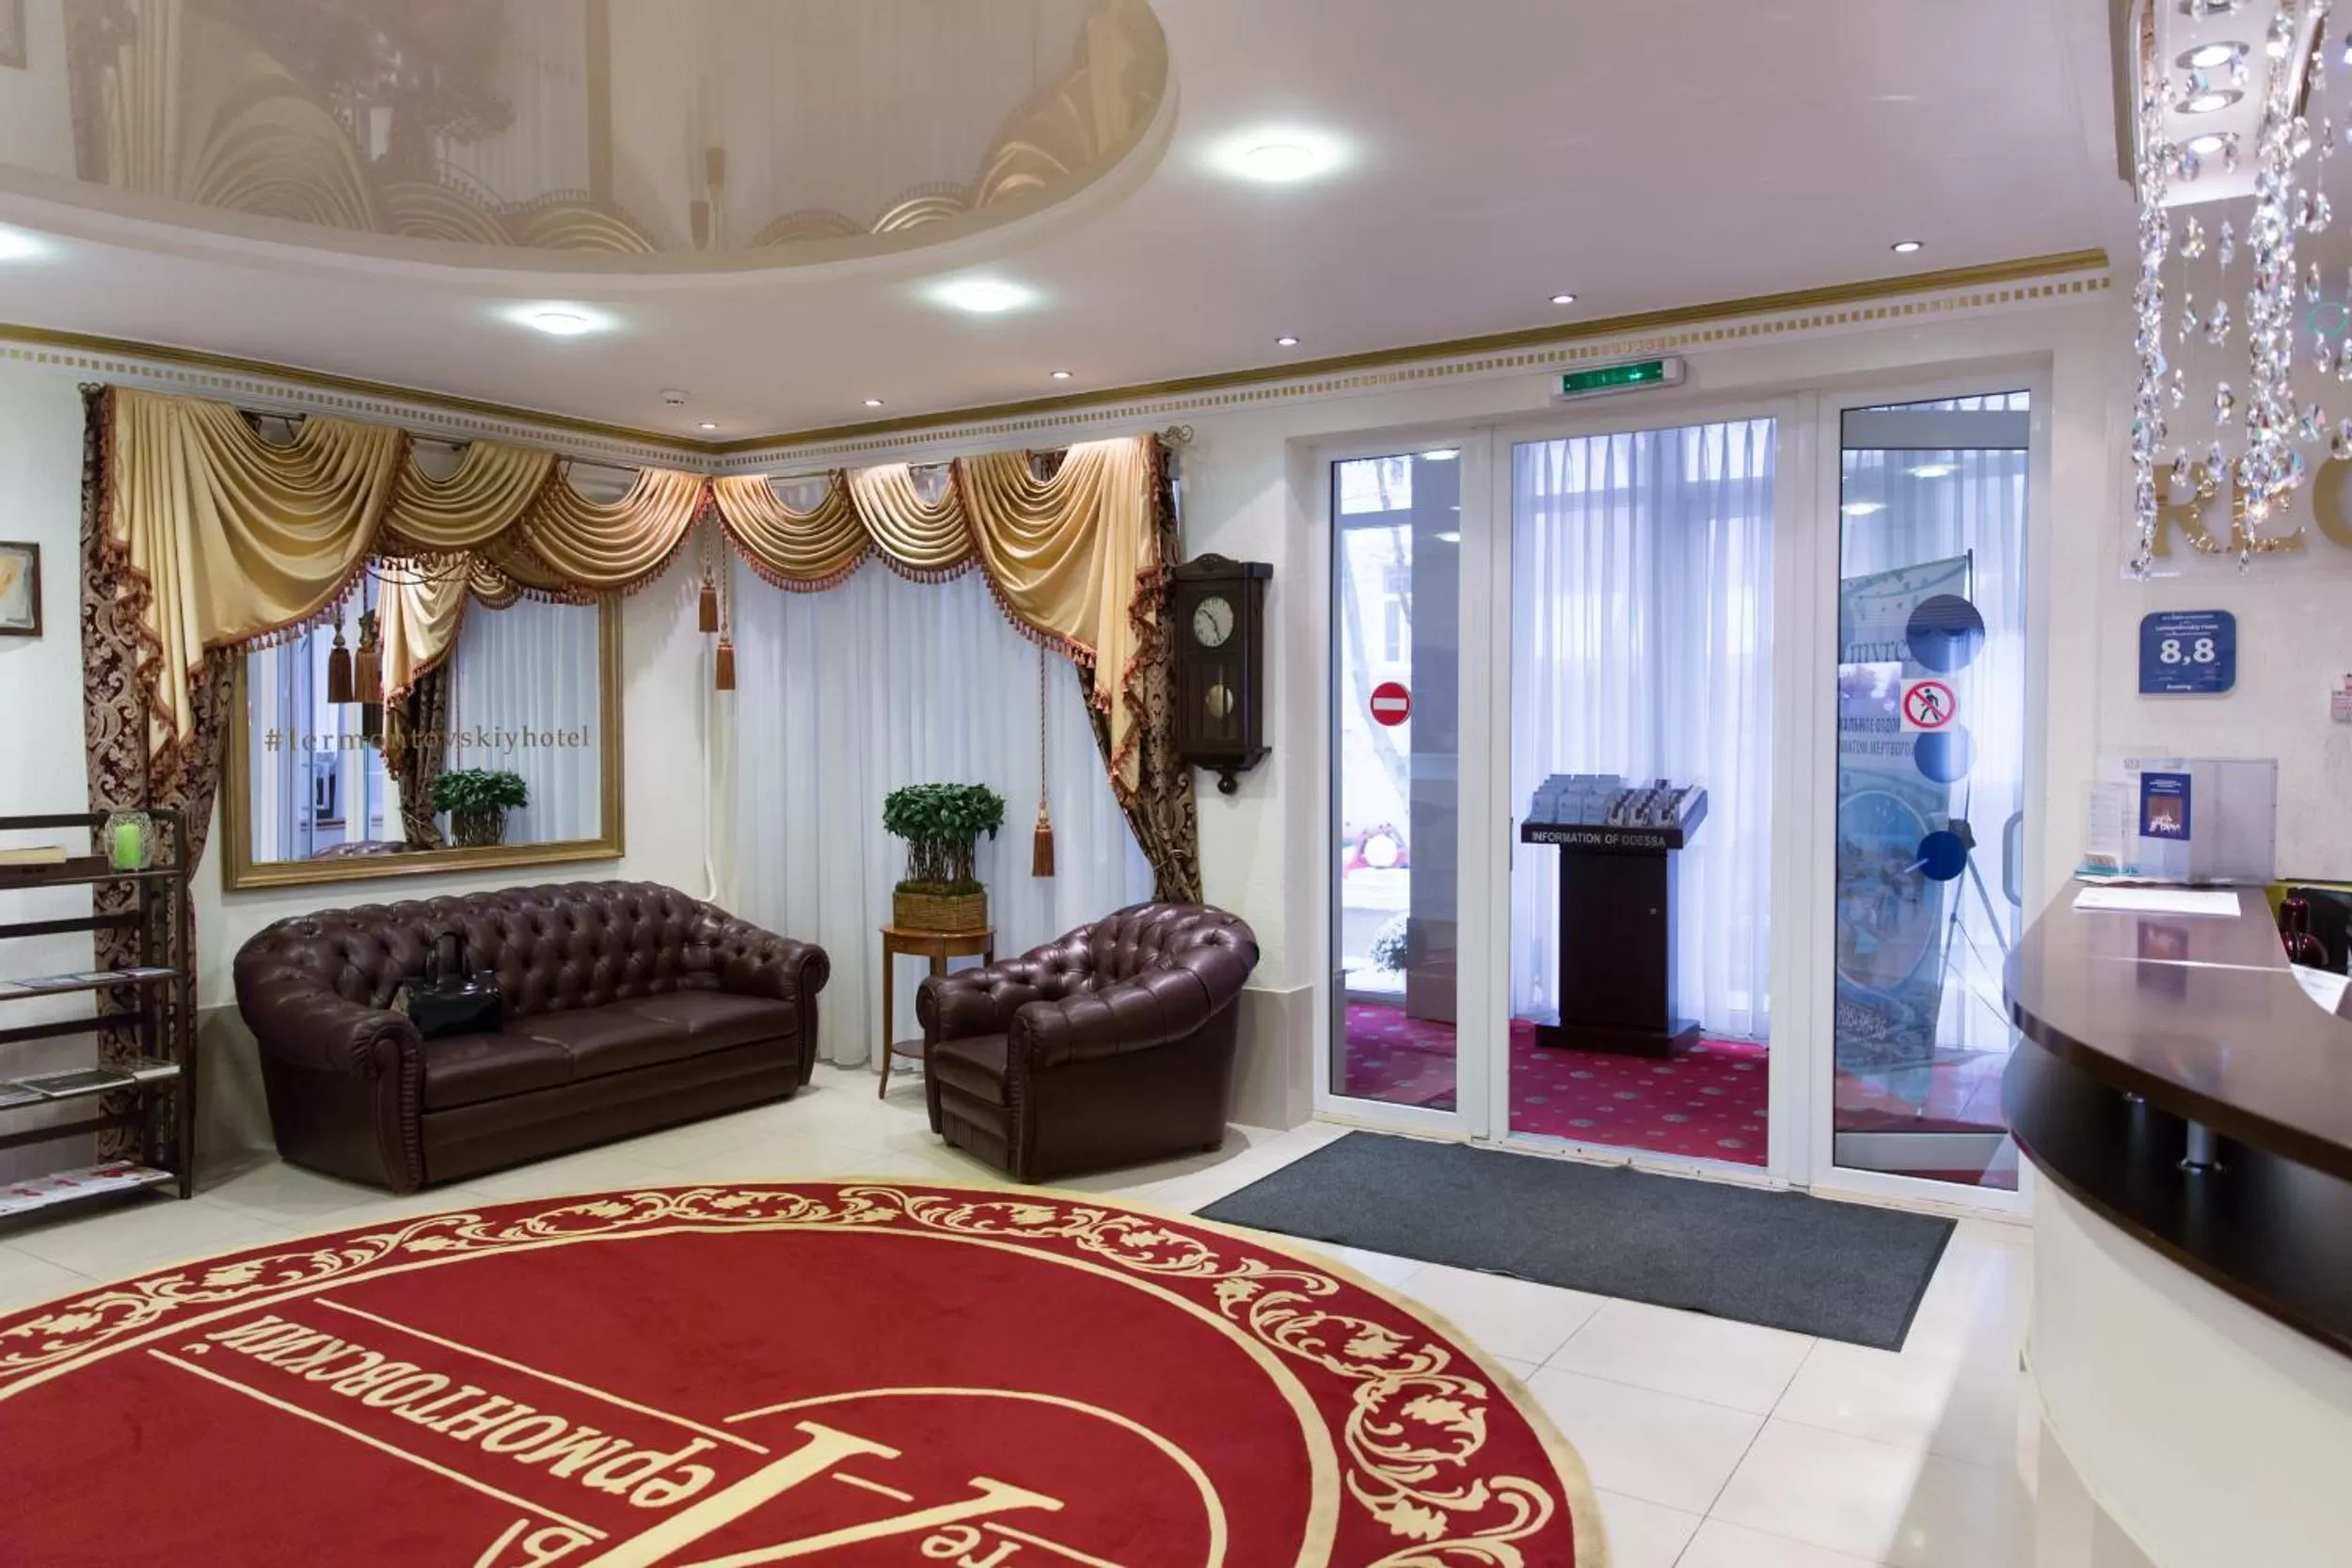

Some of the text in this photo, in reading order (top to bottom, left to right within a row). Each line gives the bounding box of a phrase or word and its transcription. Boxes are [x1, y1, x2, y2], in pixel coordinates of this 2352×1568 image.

[2159, 638, 2215, 665] 8,8
[263, 725, 589, 754] #lermontovskiyhotel
[1532, 831, 1666, 847] INFORMATION OF ODESSA
